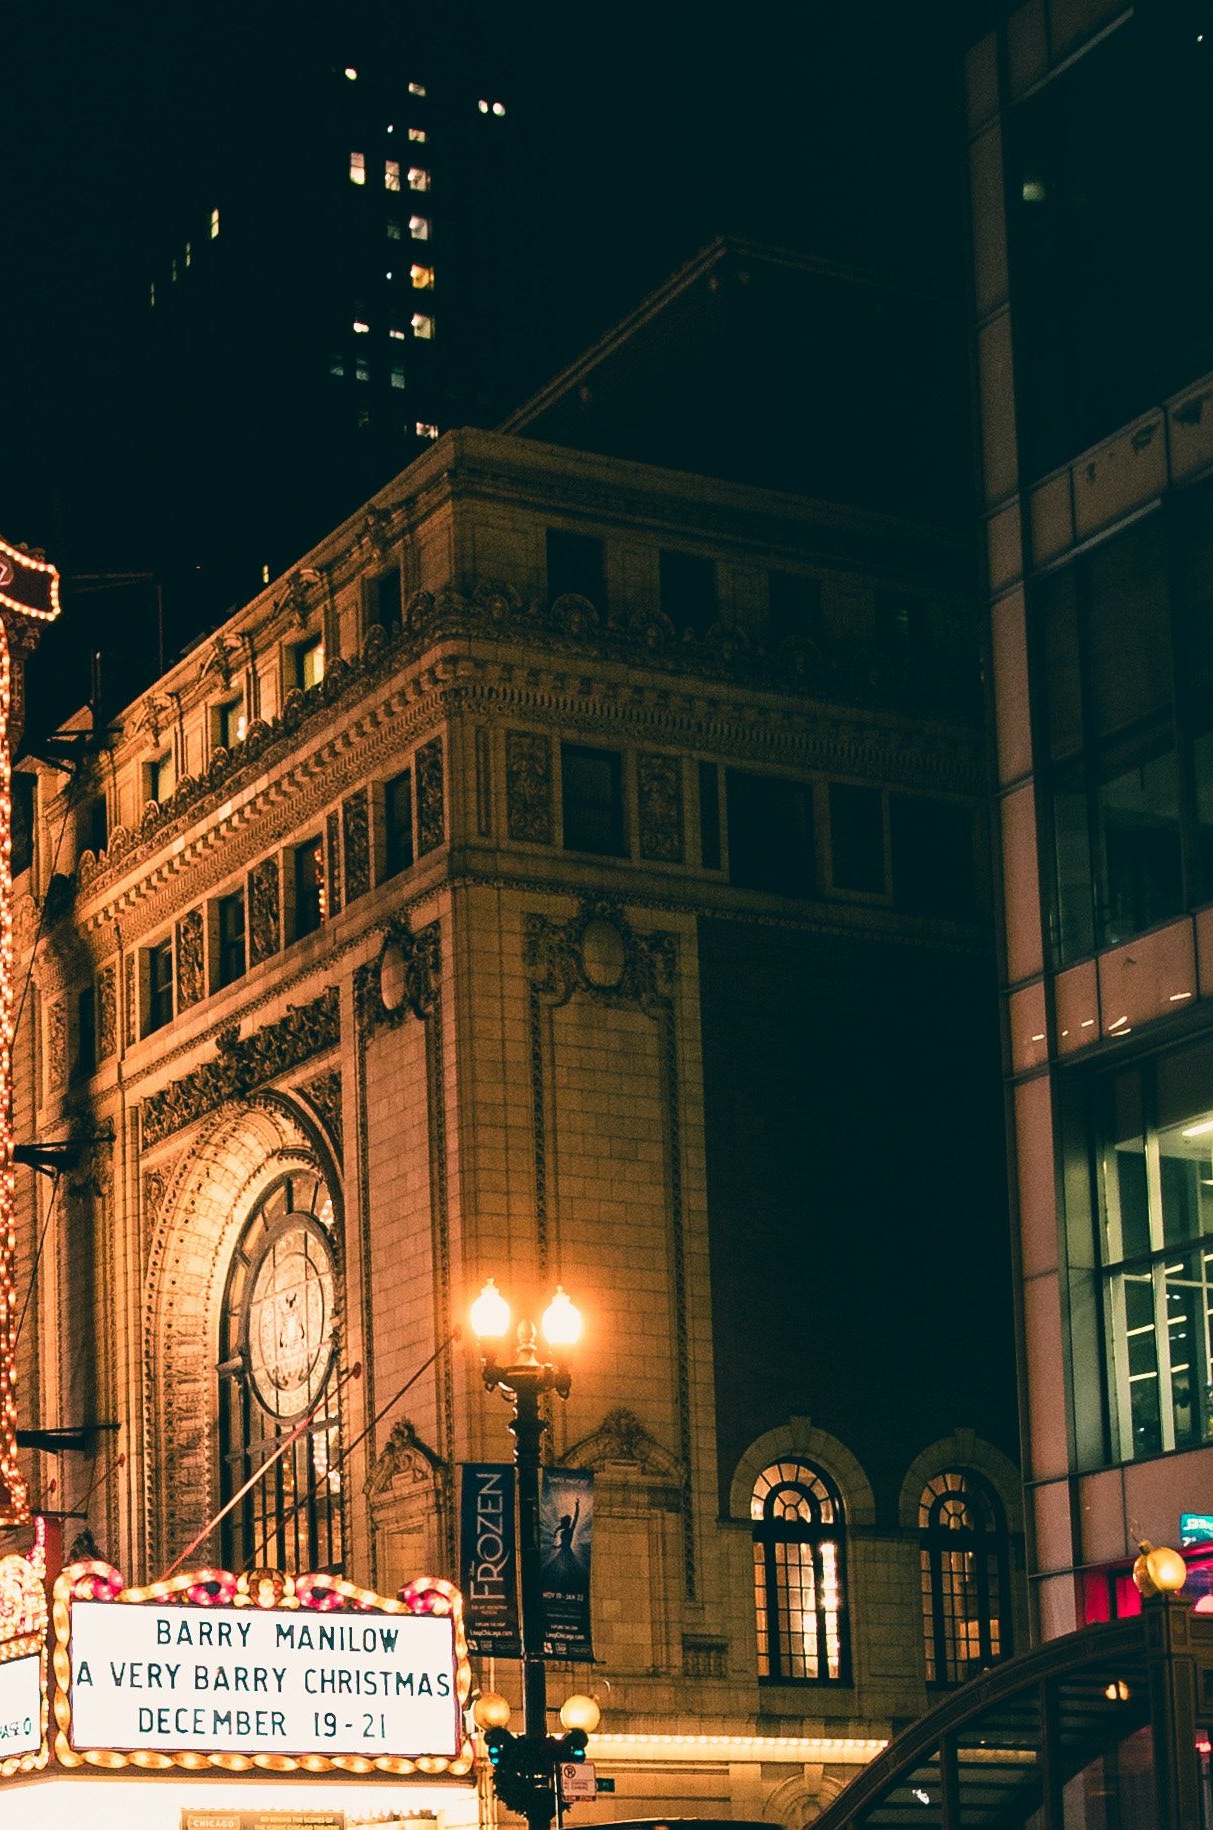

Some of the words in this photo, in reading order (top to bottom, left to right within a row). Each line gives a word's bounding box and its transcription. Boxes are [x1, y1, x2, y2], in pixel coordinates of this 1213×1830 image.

[469, 1473, 509, 1600] FROZEN
[157, 1620, 251, 1647] BARRY
[276, 1624, 398, 1653] MANILOW
[77, 1661, 93, 1686] A
[110, 1661, 181, 1689] VERY
[194, 1665, 287, 1693] BARRY
[304, 1668, 450, 1697] CHRISTMAS
[139, 1707, 287, 1736] DECEMBER
[193, 1819, 235, 1829] CHICAGO
